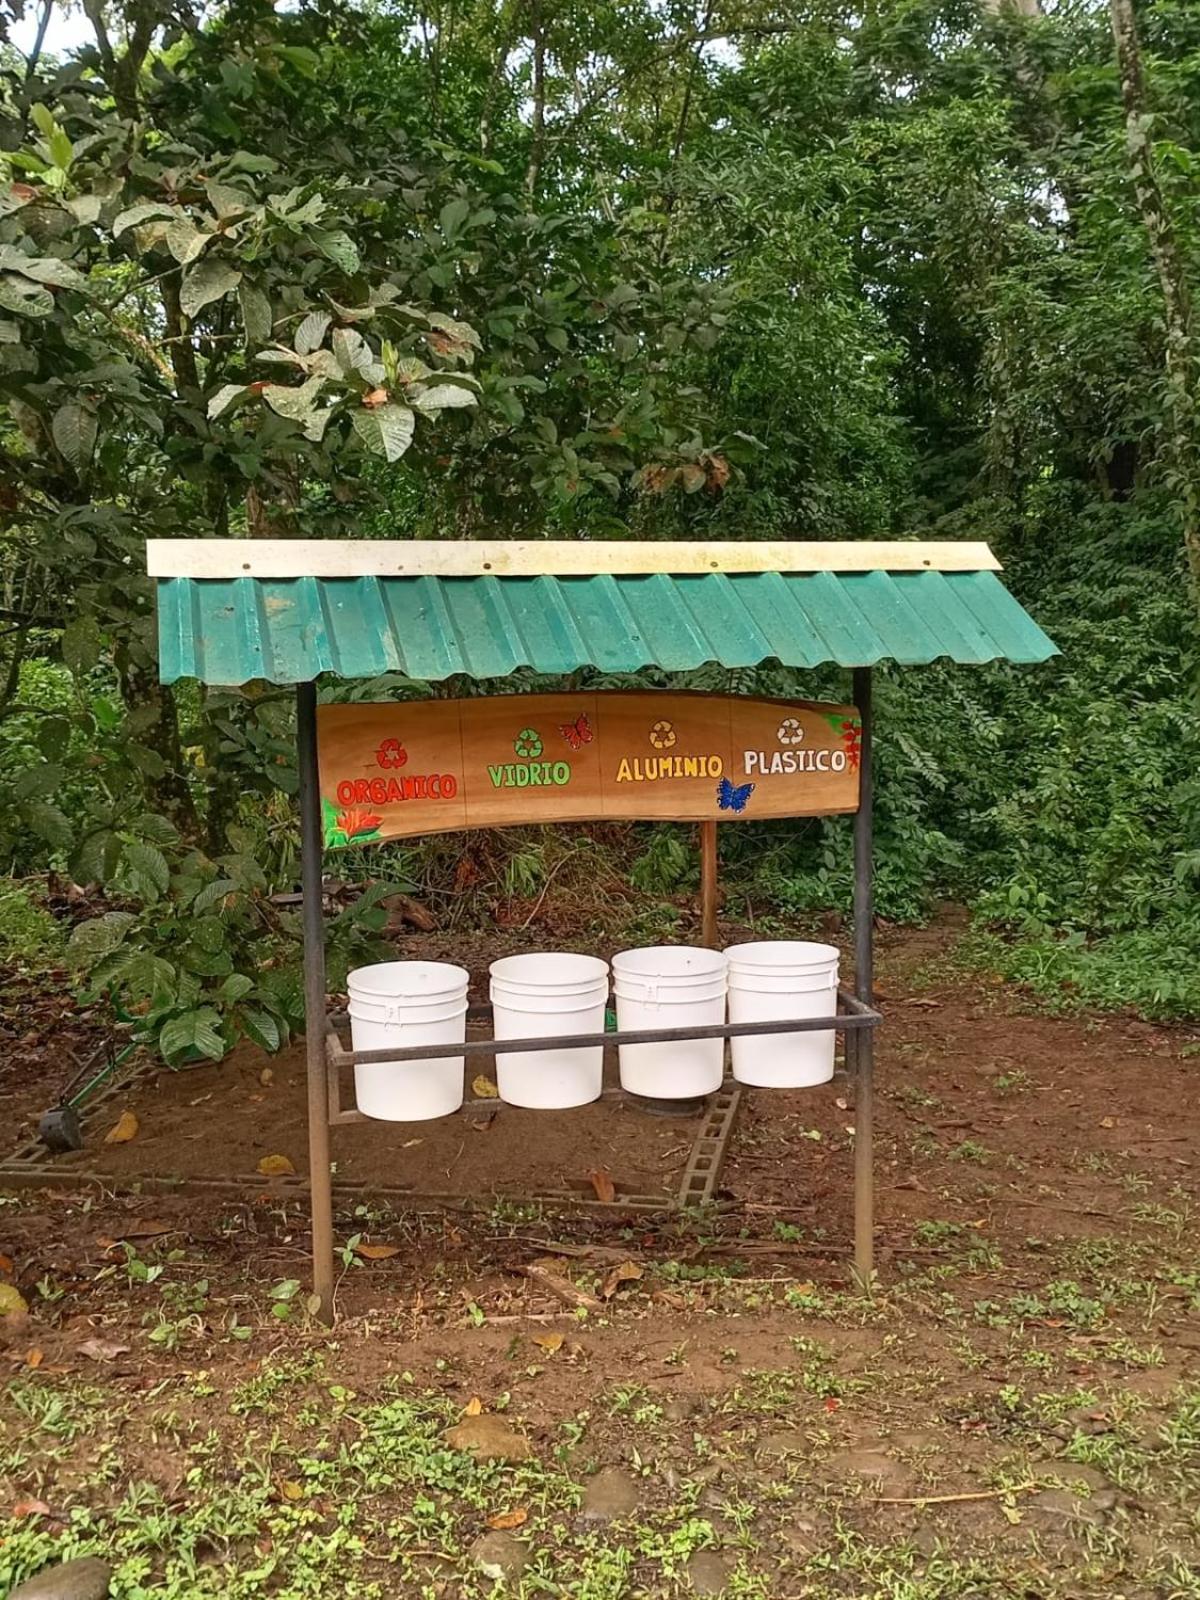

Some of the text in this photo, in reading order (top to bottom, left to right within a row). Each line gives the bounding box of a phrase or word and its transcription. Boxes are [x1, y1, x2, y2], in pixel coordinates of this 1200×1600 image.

[488, 761, 570, 788] VIDRIO
[616, 755, 723, 782] ALUMINIO
[744, 750, 846, 775] PLASTICO
[337, 774, 457, 805] ORGANICO
